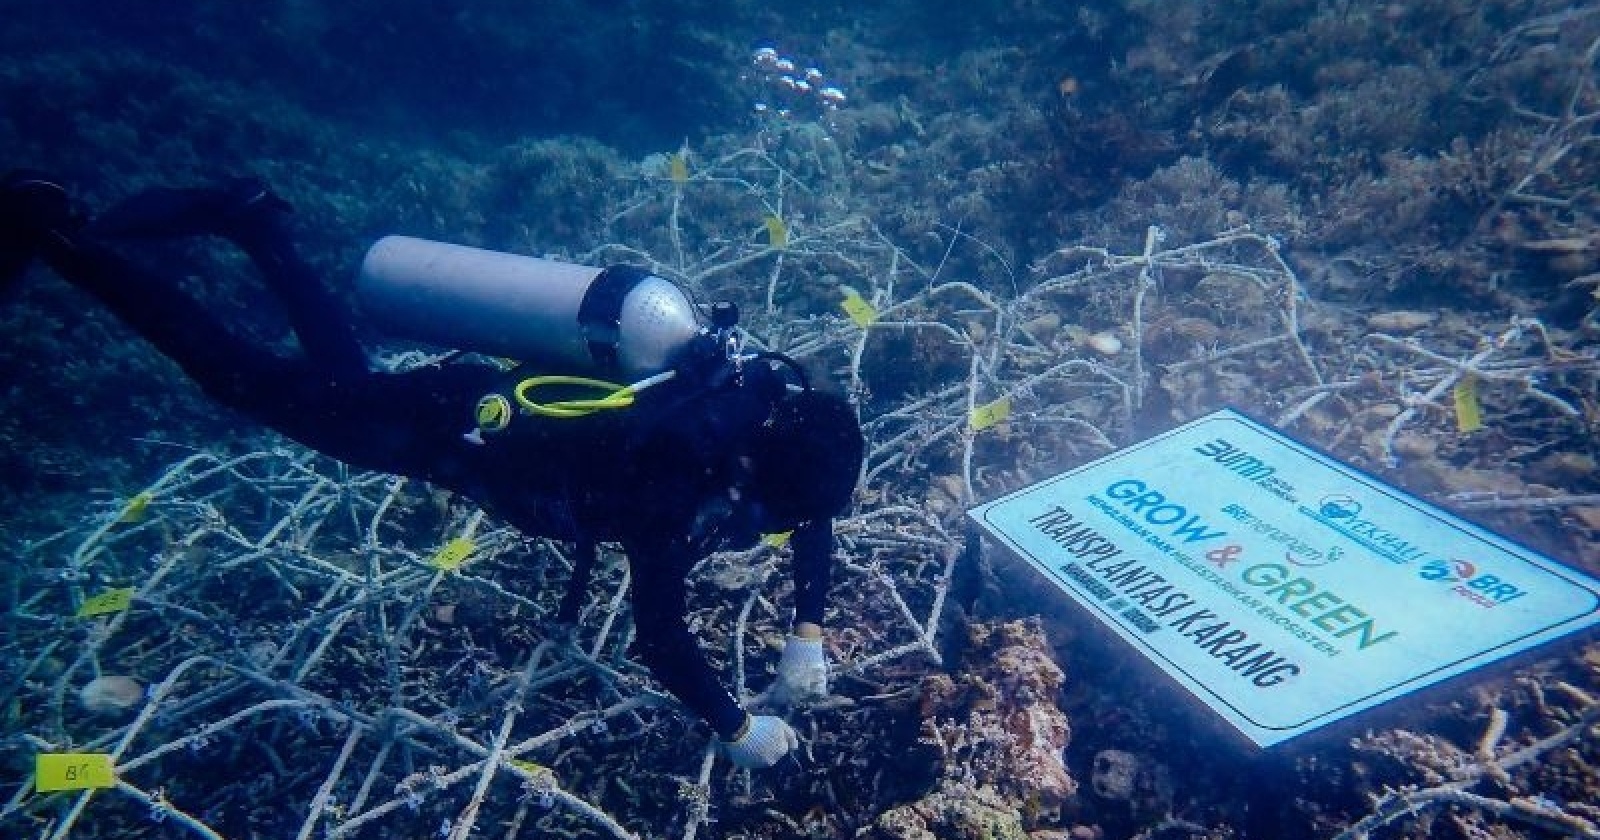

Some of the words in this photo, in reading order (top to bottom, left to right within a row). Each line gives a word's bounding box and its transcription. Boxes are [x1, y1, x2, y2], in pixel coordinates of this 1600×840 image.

[1028, 506, 1198, 618] TRANSPLANTASI
[1168, 609, 1301, 688] KARANG
[1106, 480, 1229, 544] GROW
[1205, 545, 1243, 568] &
[1242, 563, 1398, 650] GREEN
[1467, 574, 1528, 602] BRI
